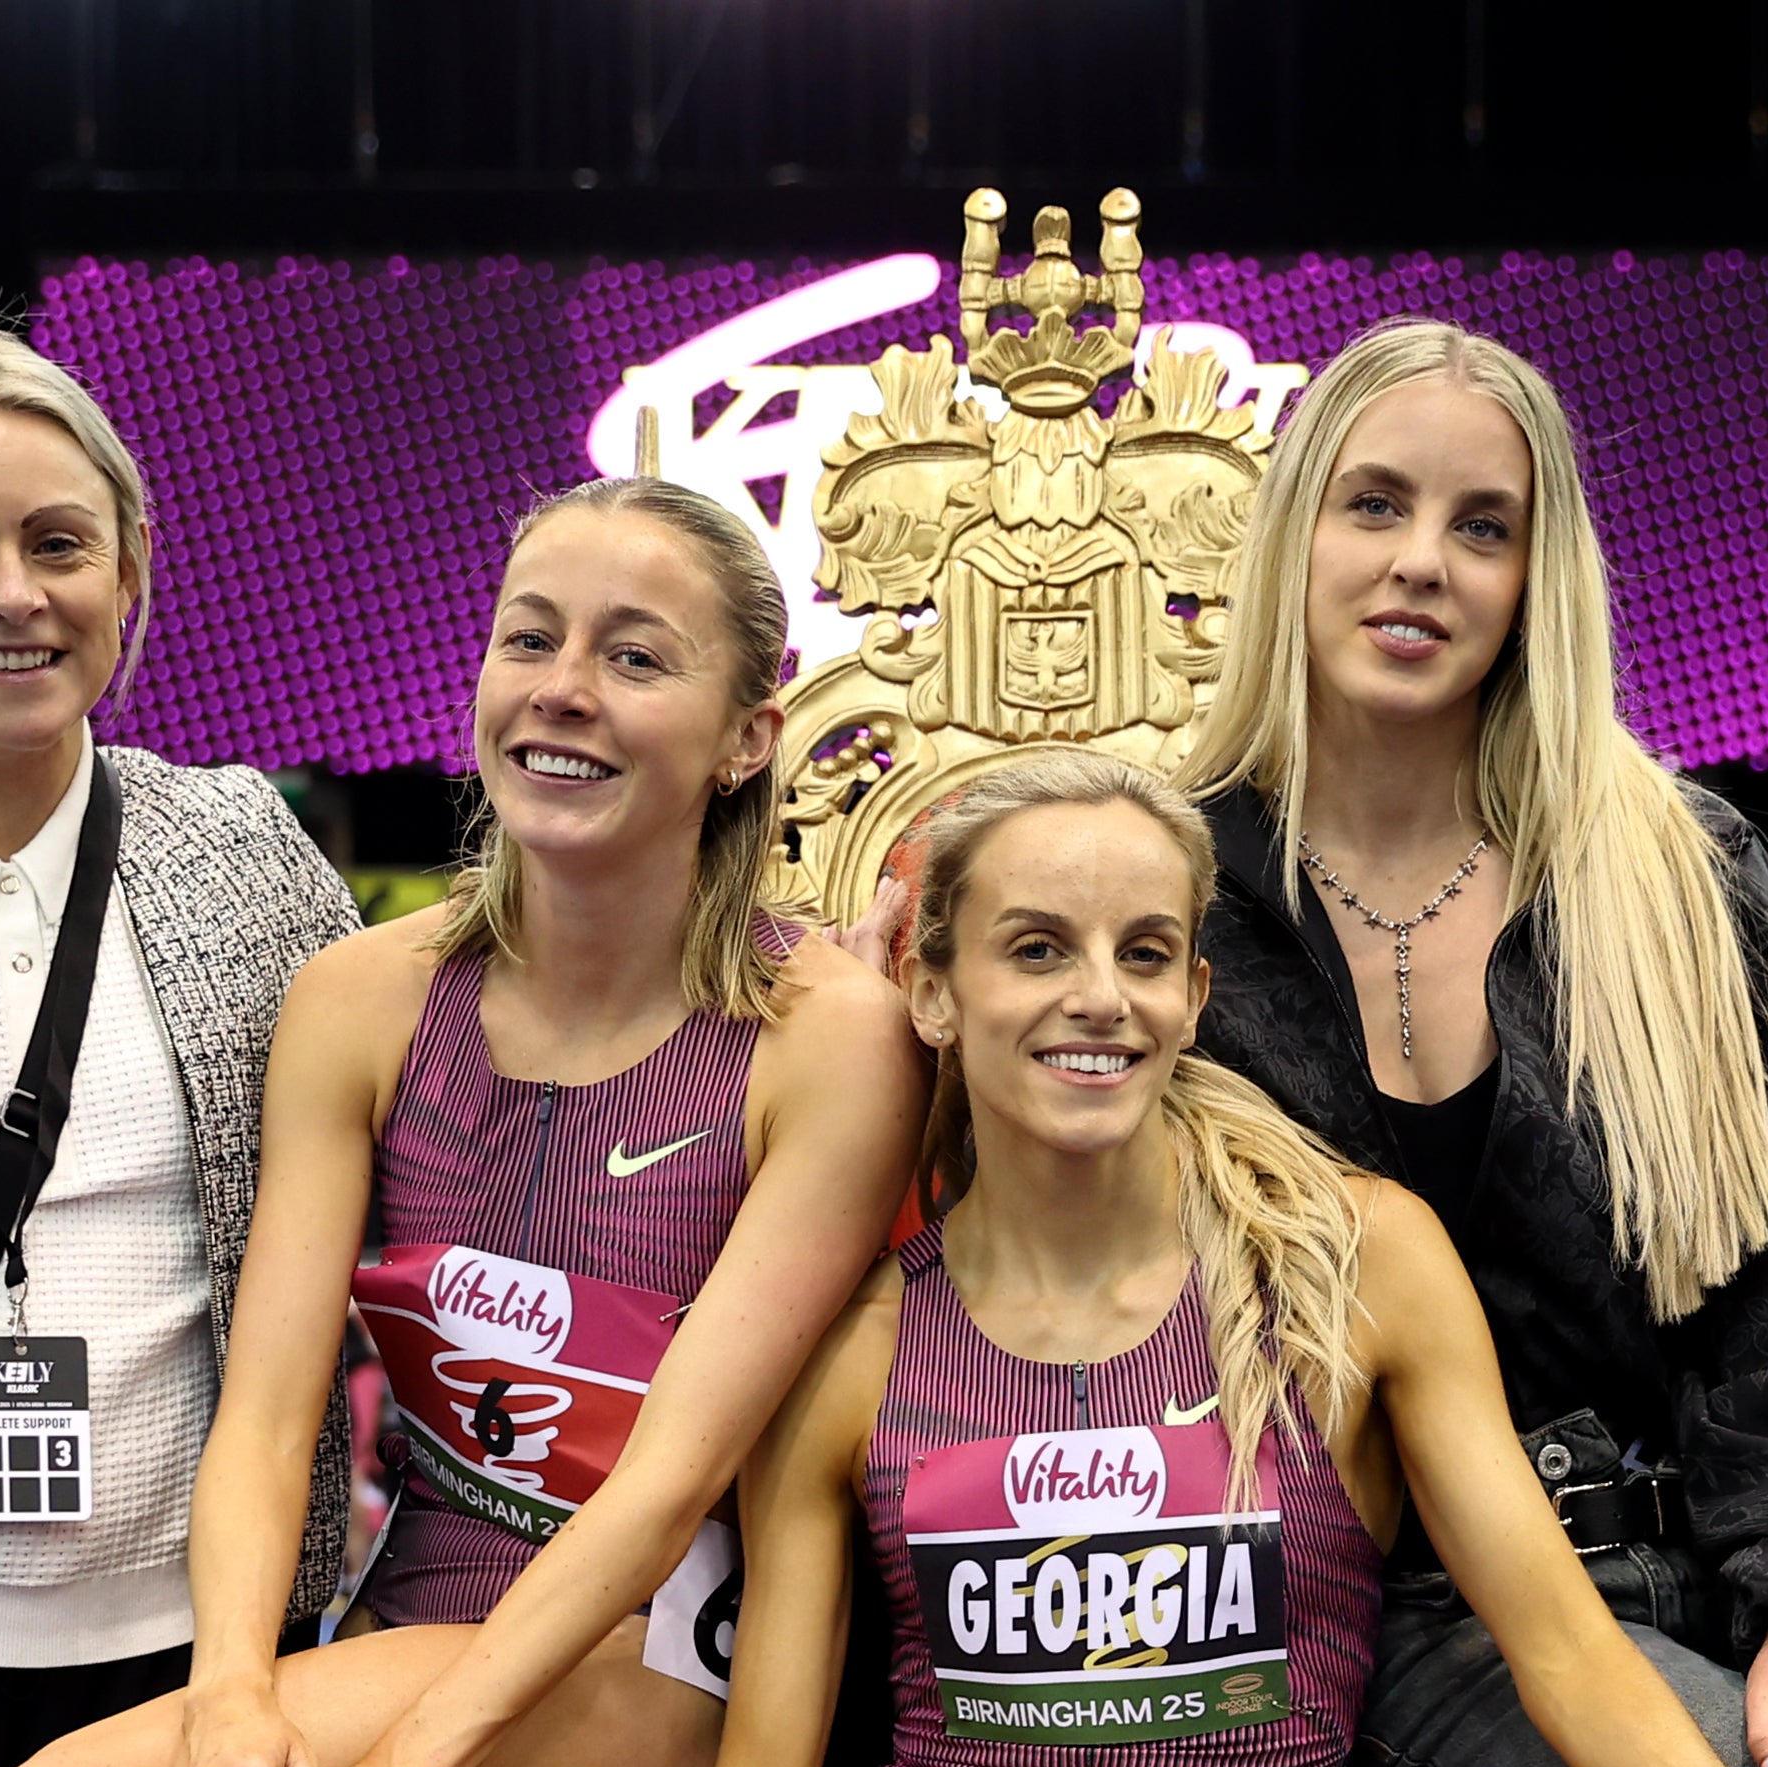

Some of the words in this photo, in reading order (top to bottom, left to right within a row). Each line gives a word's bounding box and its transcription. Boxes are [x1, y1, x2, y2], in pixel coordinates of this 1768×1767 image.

[434, 1260, 565, 1354] Vitality
[23, 1416, 72, 1429] SUPPORT
[473, 1378, 515, 1458] 6
[55, 1439, 73, 1467] 3
[1010, 1440, 1159, 1517] Vitality
[409, 1435, 534, 1533] BIRMINGHAM
[948, 1543, 1257, 1655] GEORGIA
[955, 1696, 1153, 1729] BIRMINGHAM
[1162, 1691, 1205, 1721] 25
[1215, 1698, 1249, 1711] INDOOR
[1250, 1693, 1273, 1704] TOUR
[1228, 1703, 1263, 1716] BRONZE
